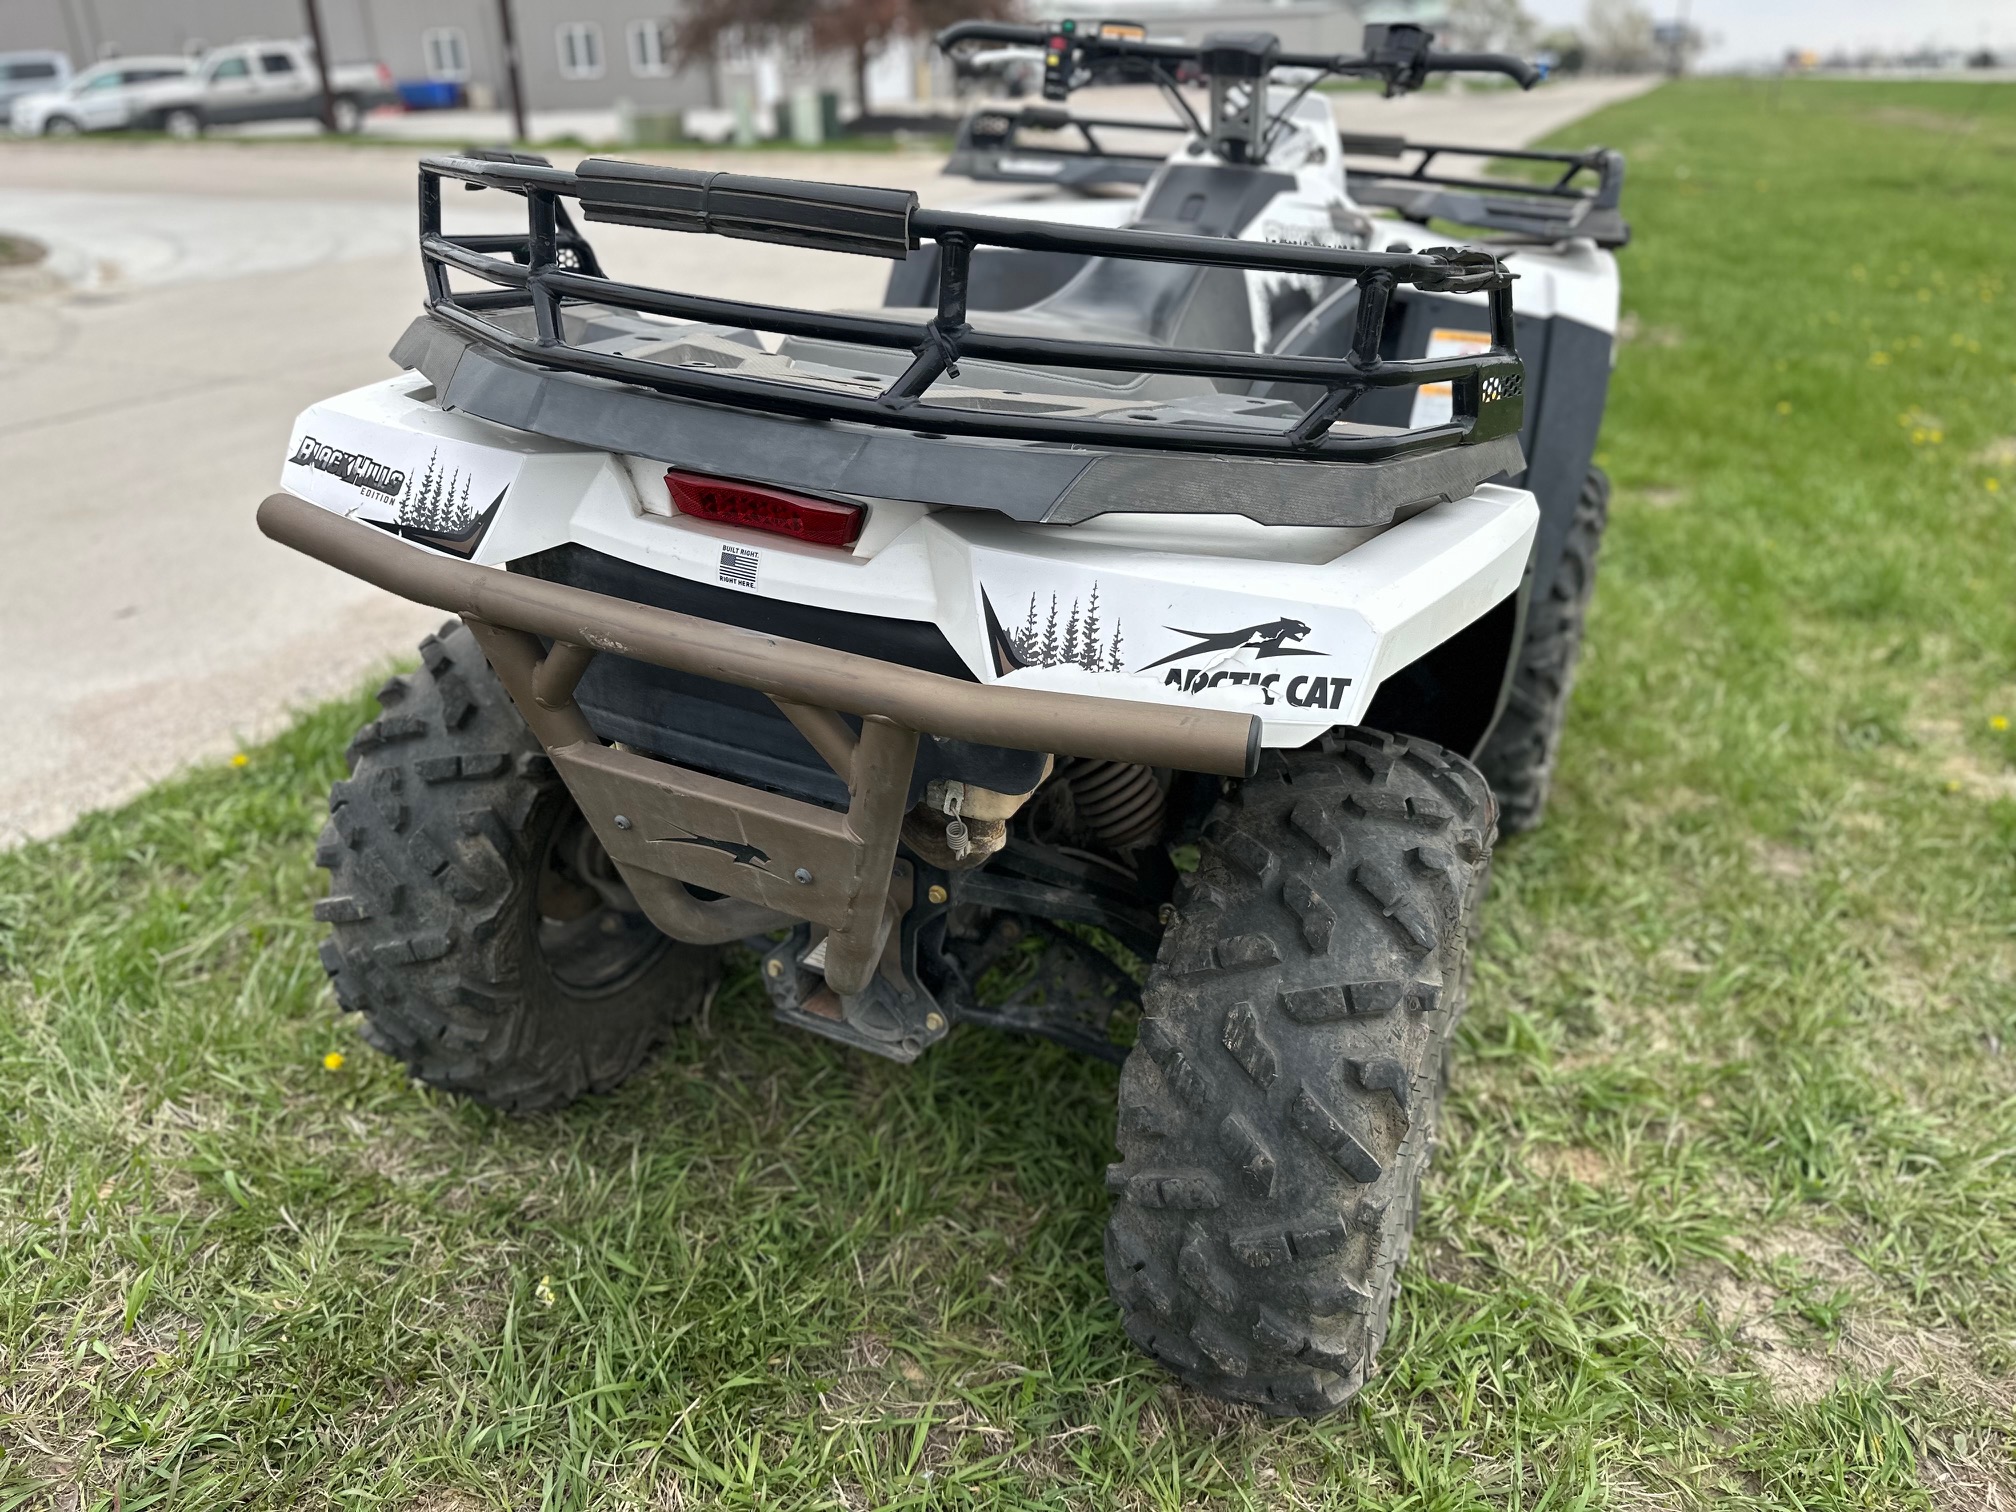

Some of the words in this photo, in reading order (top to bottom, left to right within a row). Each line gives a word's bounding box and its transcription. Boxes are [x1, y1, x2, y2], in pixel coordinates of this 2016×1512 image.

[360, 487, 396, 506] EDITION
[722, 544, 740, 554] BUILT
[719, 575, 737, 585] RIGHT
[1286, 675, 1353, 711] CAT
